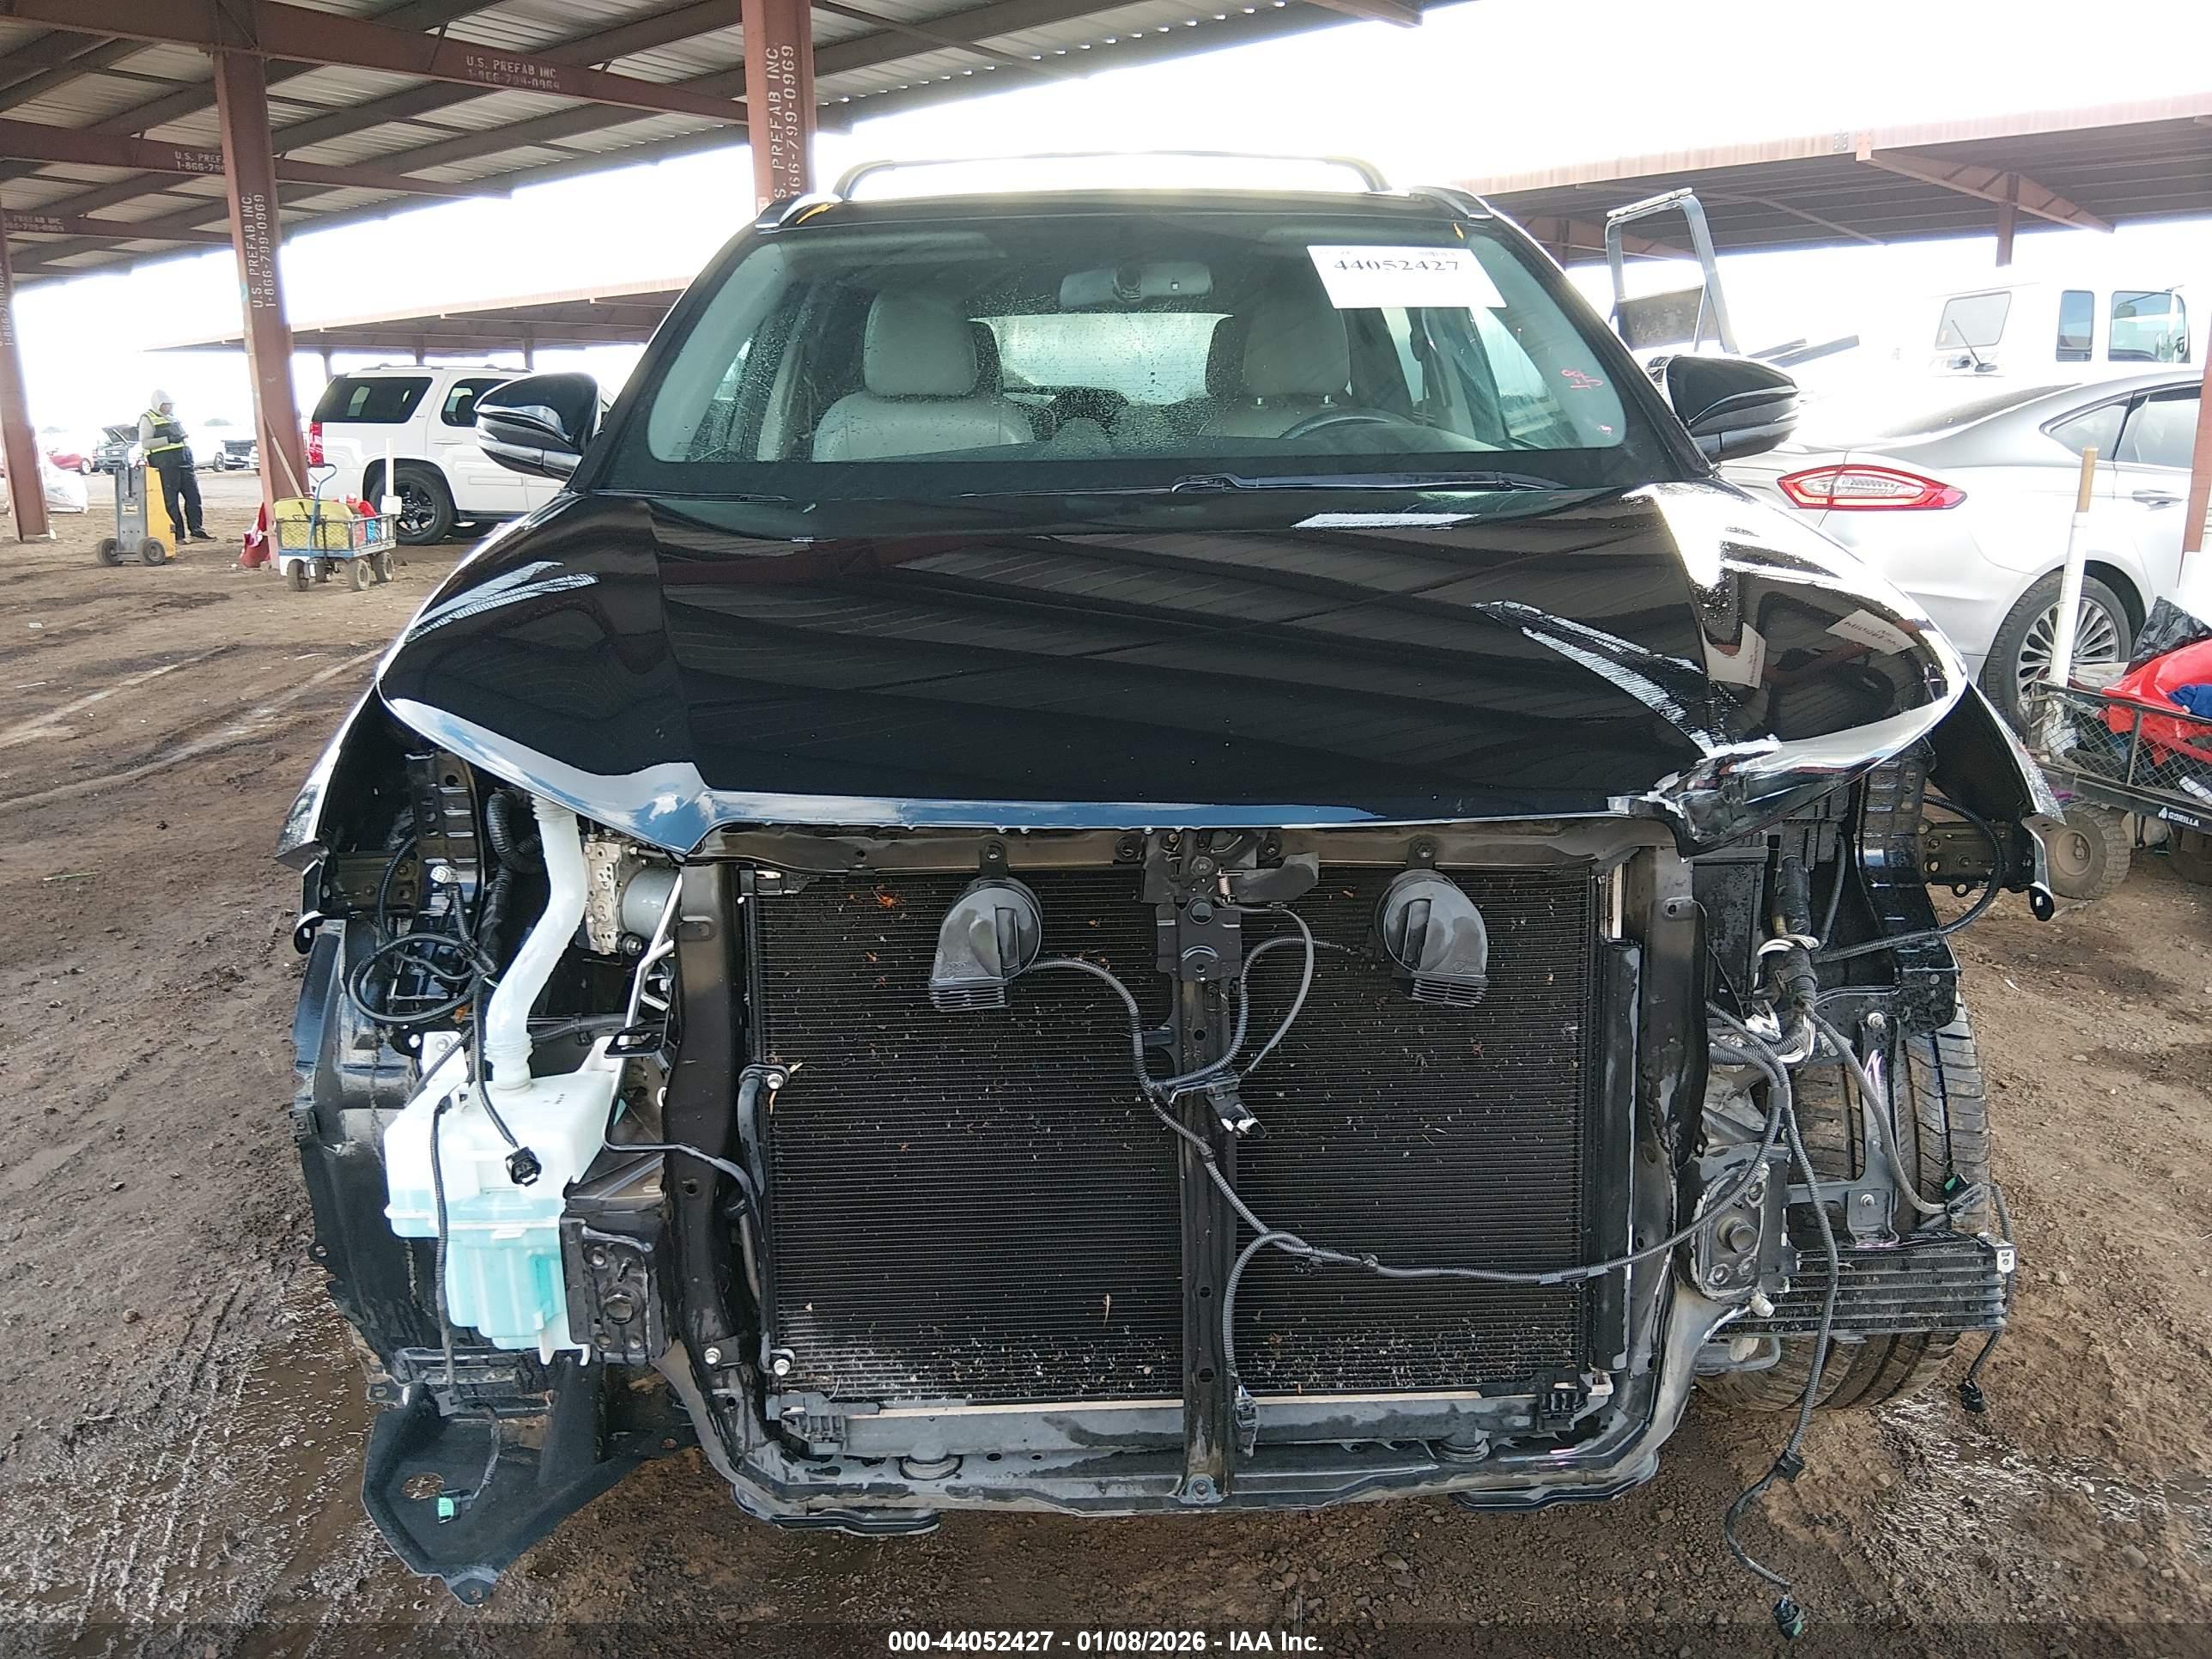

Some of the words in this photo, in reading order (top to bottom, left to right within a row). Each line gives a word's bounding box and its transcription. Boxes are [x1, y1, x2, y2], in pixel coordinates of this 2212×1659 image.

[466, 55, 488, 69] U.S.
[493, 59, 535, 76] PREFAB
[769, 91, 785, 170] PREFAB
[174, 150, 194, 161] U.S.
[244, 224, 260, 276] PREFAB
[253, 194, 276, 307] 1-866-799-0969
[1334, 259, 1459, 271] 44052427
[252, 283, 264, 308] U.S.
[2168, 811, 2199, 827] GORILLA
